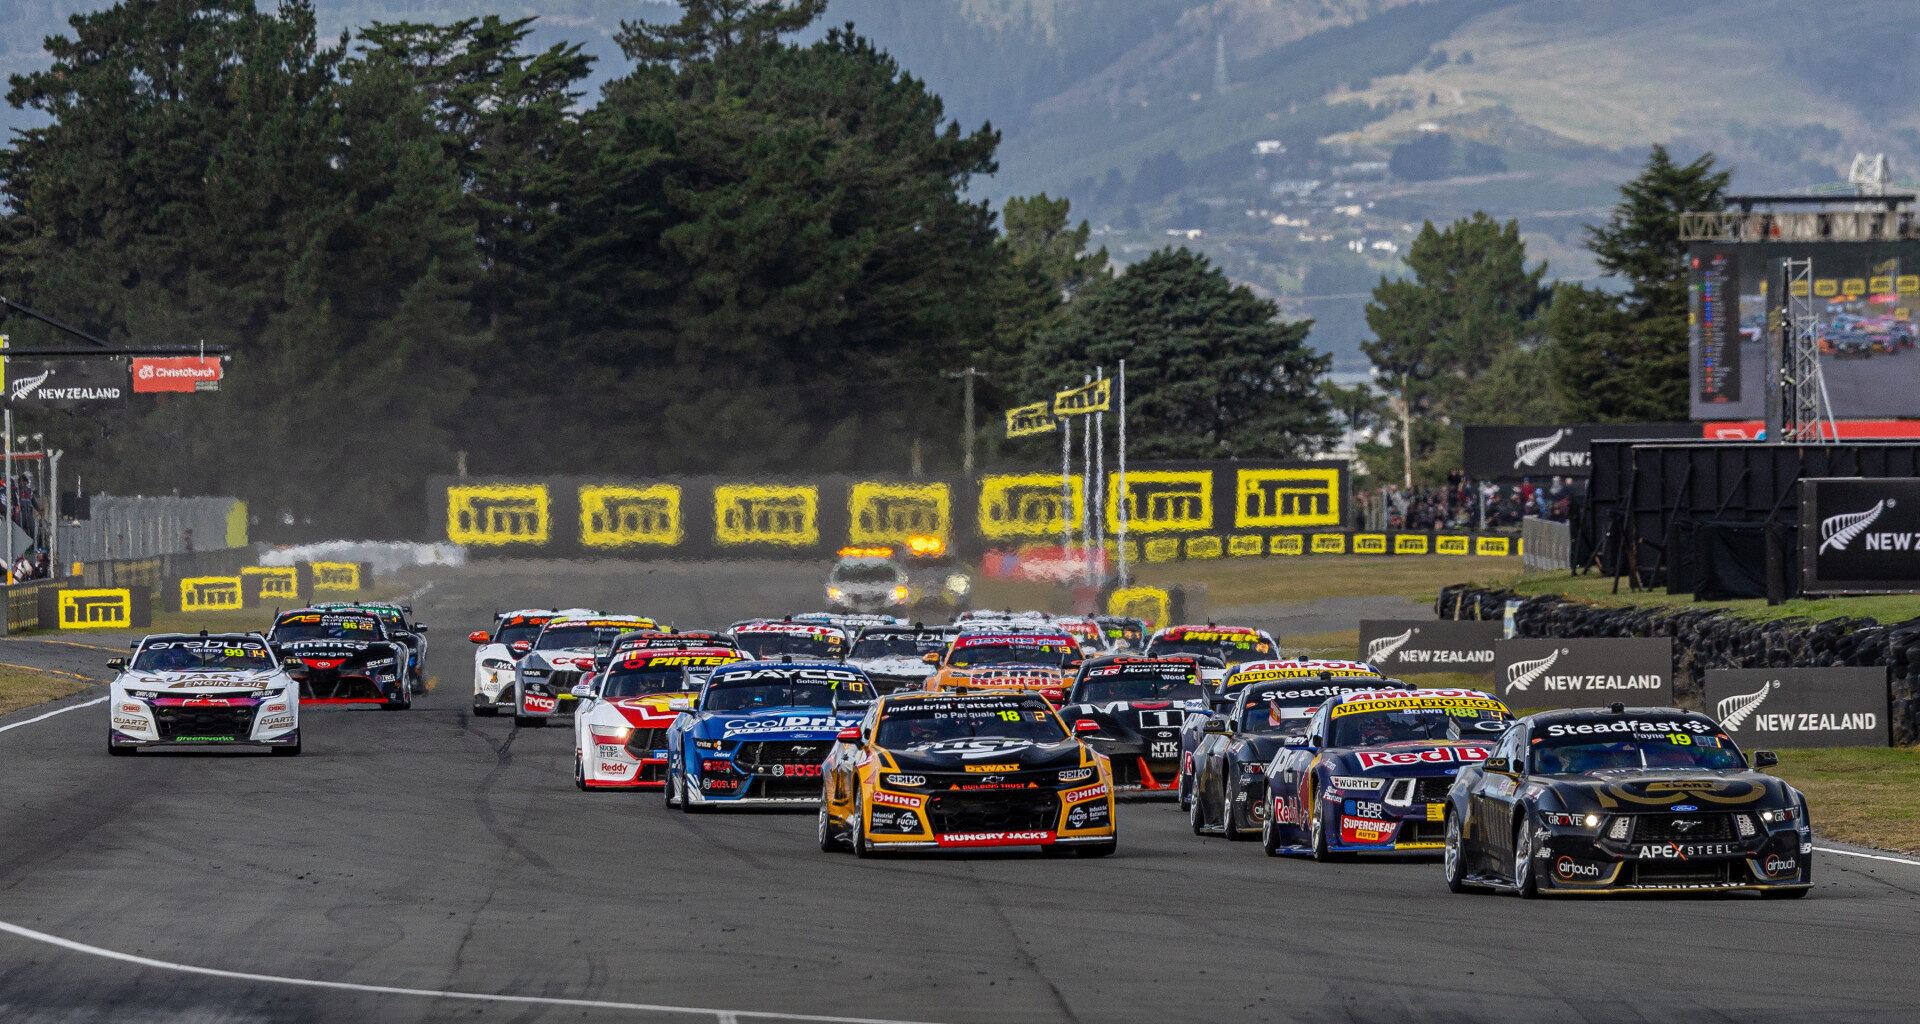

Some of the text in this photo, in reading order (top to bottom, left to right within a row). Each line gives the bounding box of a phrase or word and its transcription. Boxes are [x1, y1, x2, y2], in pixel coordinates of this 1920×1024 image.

[38, 388, 120, 400] NEW ZEALAND
[1548, 452, 1582, 467] NEW
[1866, 532, 1906, 550] NEW
[62, 593, 127, 625] itm
[1184, 632, 1260, 642] PIRTEK
[149, 640, 262, 650] erebus
[224, 648, 244, 657] 99
[1400, 650, 1495, 662] NEW ZEALAND
[648, 656, 742, 667] PIRTEK
[1244, 662, 1366, 672] AMPOL
[723, 668, 858, 682] DAYCO
[1090, 668, 1120, 676] GR
[1232, 669, 1300, 683] NATIONAL
[140, 674, 270, 683] QUARTZ
[970, 678, 1063, 686] Rentals
[1544, 674, 1661, 690] NEW ZEALAND
[828, 680, 840, 690] 7
[525, 696, 556, 709] RYCO
[1348, 690, 1486, 703] AMPOL
[888, 702, 1019, 712] Industrial Batteries
[1336, 698, 1500, 714] NATIONAL STORAGE
[114, 718, 148, 726] QUARTZ
[260, 716, 294, 724] QUARTZ
[950, 711, 996, 720] Pasquale
[996, 710, 1020, 722] 18
[1034, 712, 1046, 722] 2
[1153, 711, 1168, 726] 1
[1756, 713, 1876, 731] NEW ZEALAND
[1548, 720, 1682, 737] Steadfast
[1666, 733, 1692, 746] 19
[1151, 741, 1178, 752] NTK
[1356, 748, 1454, 771] Red
[602, 762, 628, 774] Reddy
[784, 764, 822, 776] BOSC
[1058, 768, 1092, 780] SEIKO
[888, 774, 926, 785] SEIKO
[1339, 778, 1368, 788] WÜRTH
[1079, 784, 1108, 798] HINO
[884, 796, 920, 807] HINO
[1357, 801, 1382, 812] QUAD
[1068, 813, 1088, 821] FUCHS
[1357, 810, 1382, 820] LOCK
[1548, 815, 1583, 826] GROVE
[1344, 816, 1396, 834] SUPERCHEAP
[944, 831, 1048, 842] HUNGRY JACK'S
[1638, 842, 1732, 860] APEX STEEL
[1560, 862, 1598, 876] airtouch
[1768, 856, 1796, 871] airtouch
